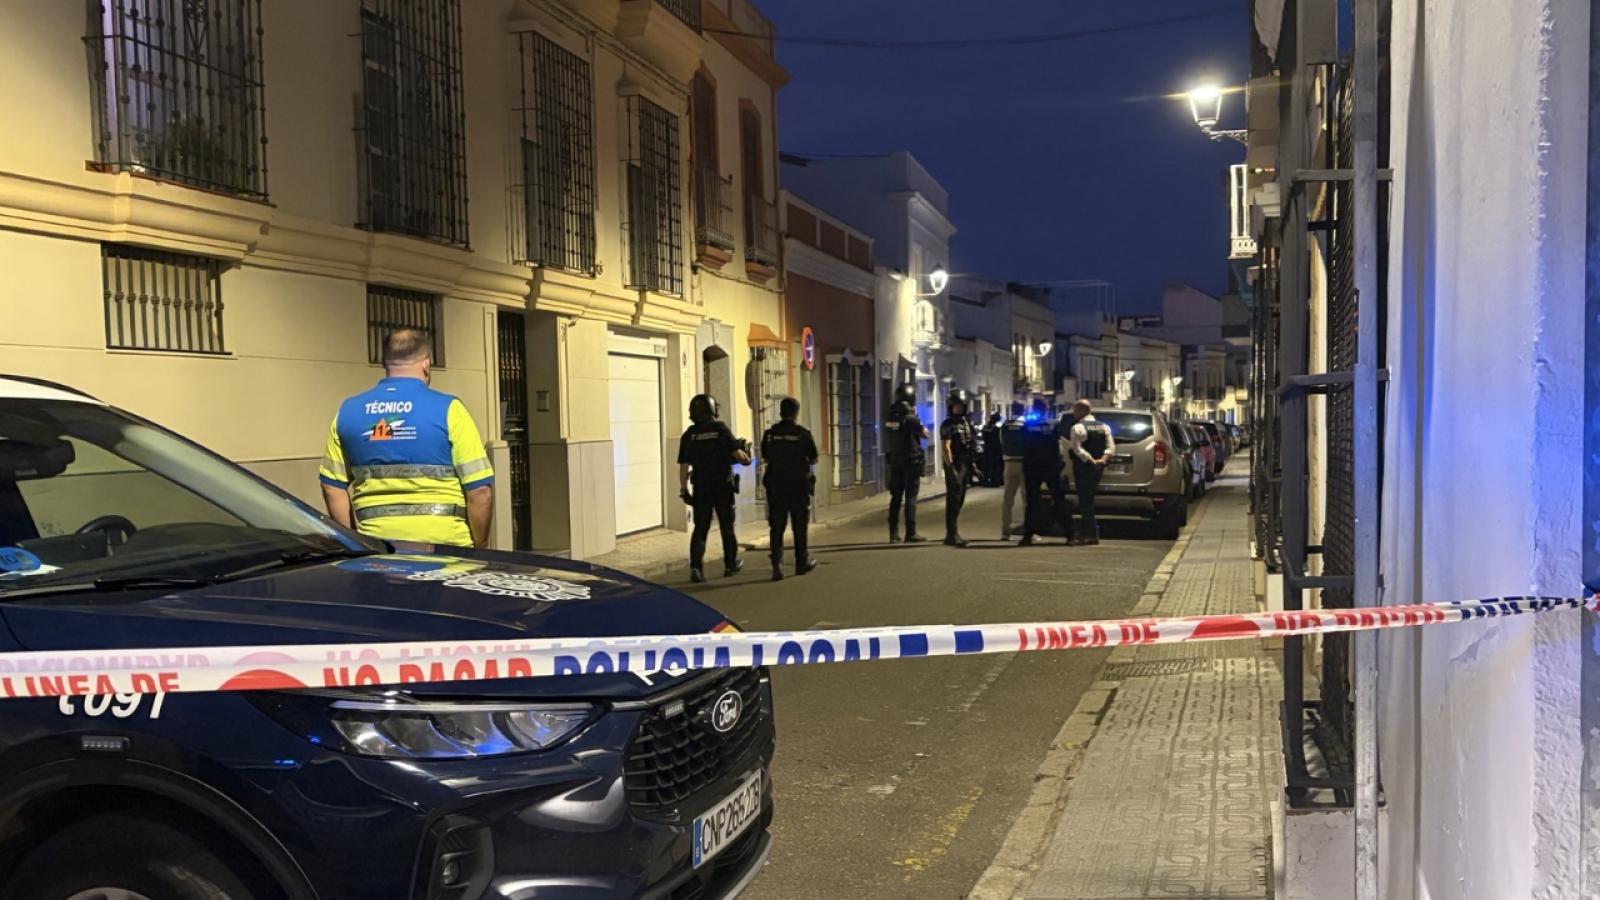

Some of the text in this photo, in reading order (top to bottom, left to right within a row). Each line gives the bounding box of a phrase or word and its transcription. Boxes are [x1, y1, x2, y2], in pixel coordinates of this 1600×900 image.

[365, 400, 413, 415] TÉCNICO
[1119, 619, 1160, 646] DE
[719, 696, 739, 727] Ford
